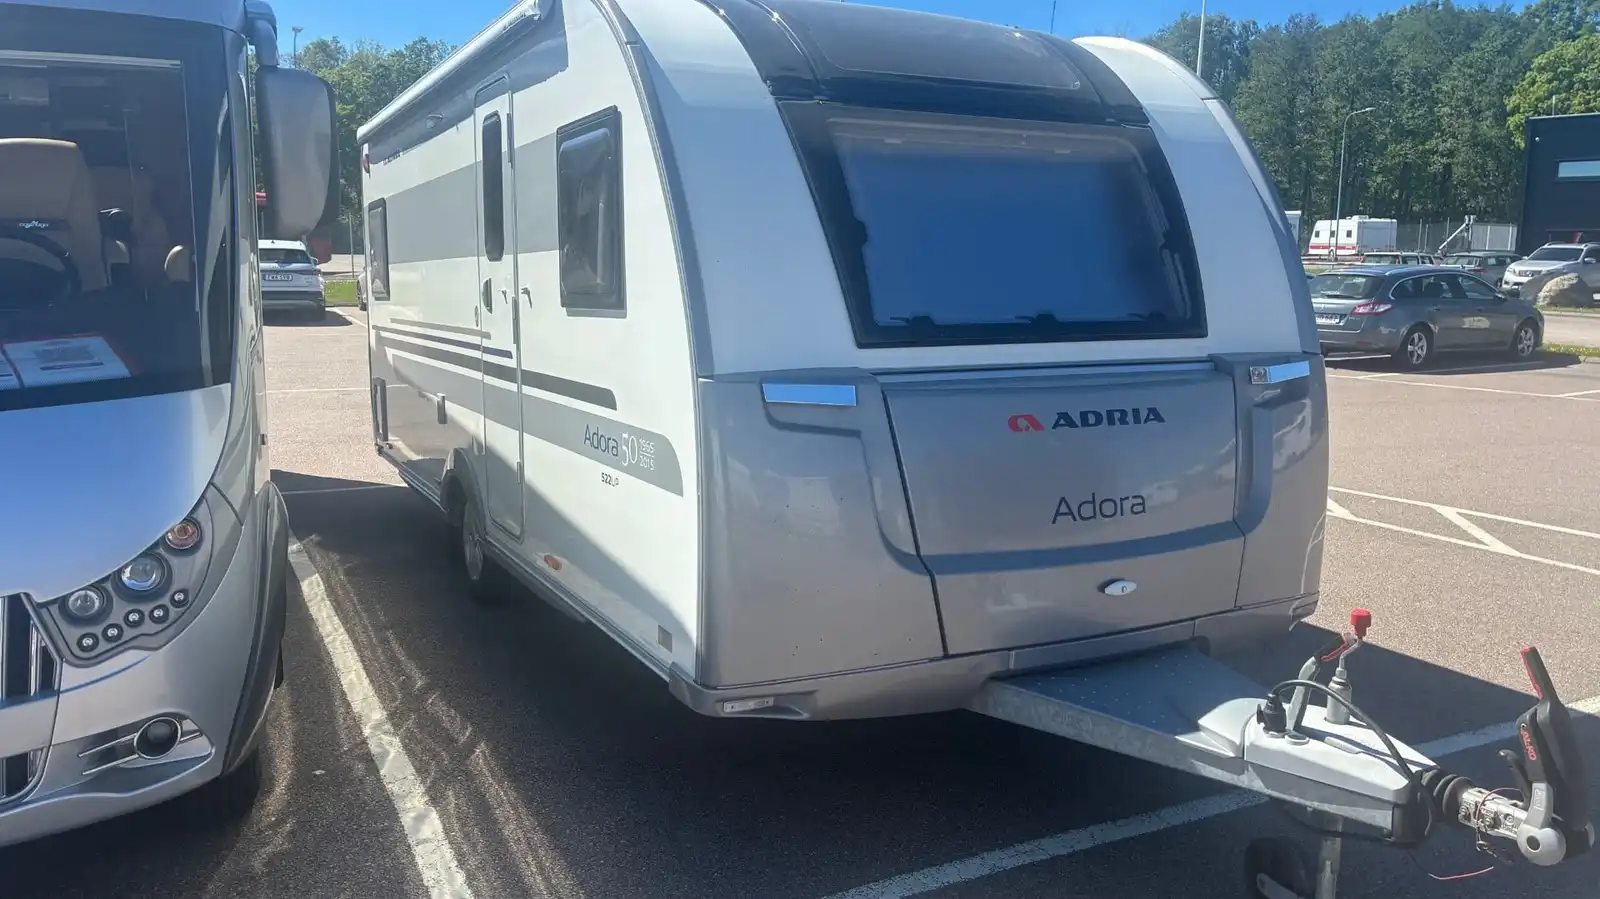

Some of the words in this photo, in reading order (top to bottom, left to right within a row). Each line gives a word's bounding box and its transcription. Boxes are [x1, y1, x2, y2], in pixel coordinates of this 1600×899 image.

[1051, 407, 1166, 430] ADRIA
[583, 423, 619, 457] Adora
[621, 432, 638, 467] 50
[639, 455, 655, 471] 2015
[1051, 492, 1147, 525] Adora
